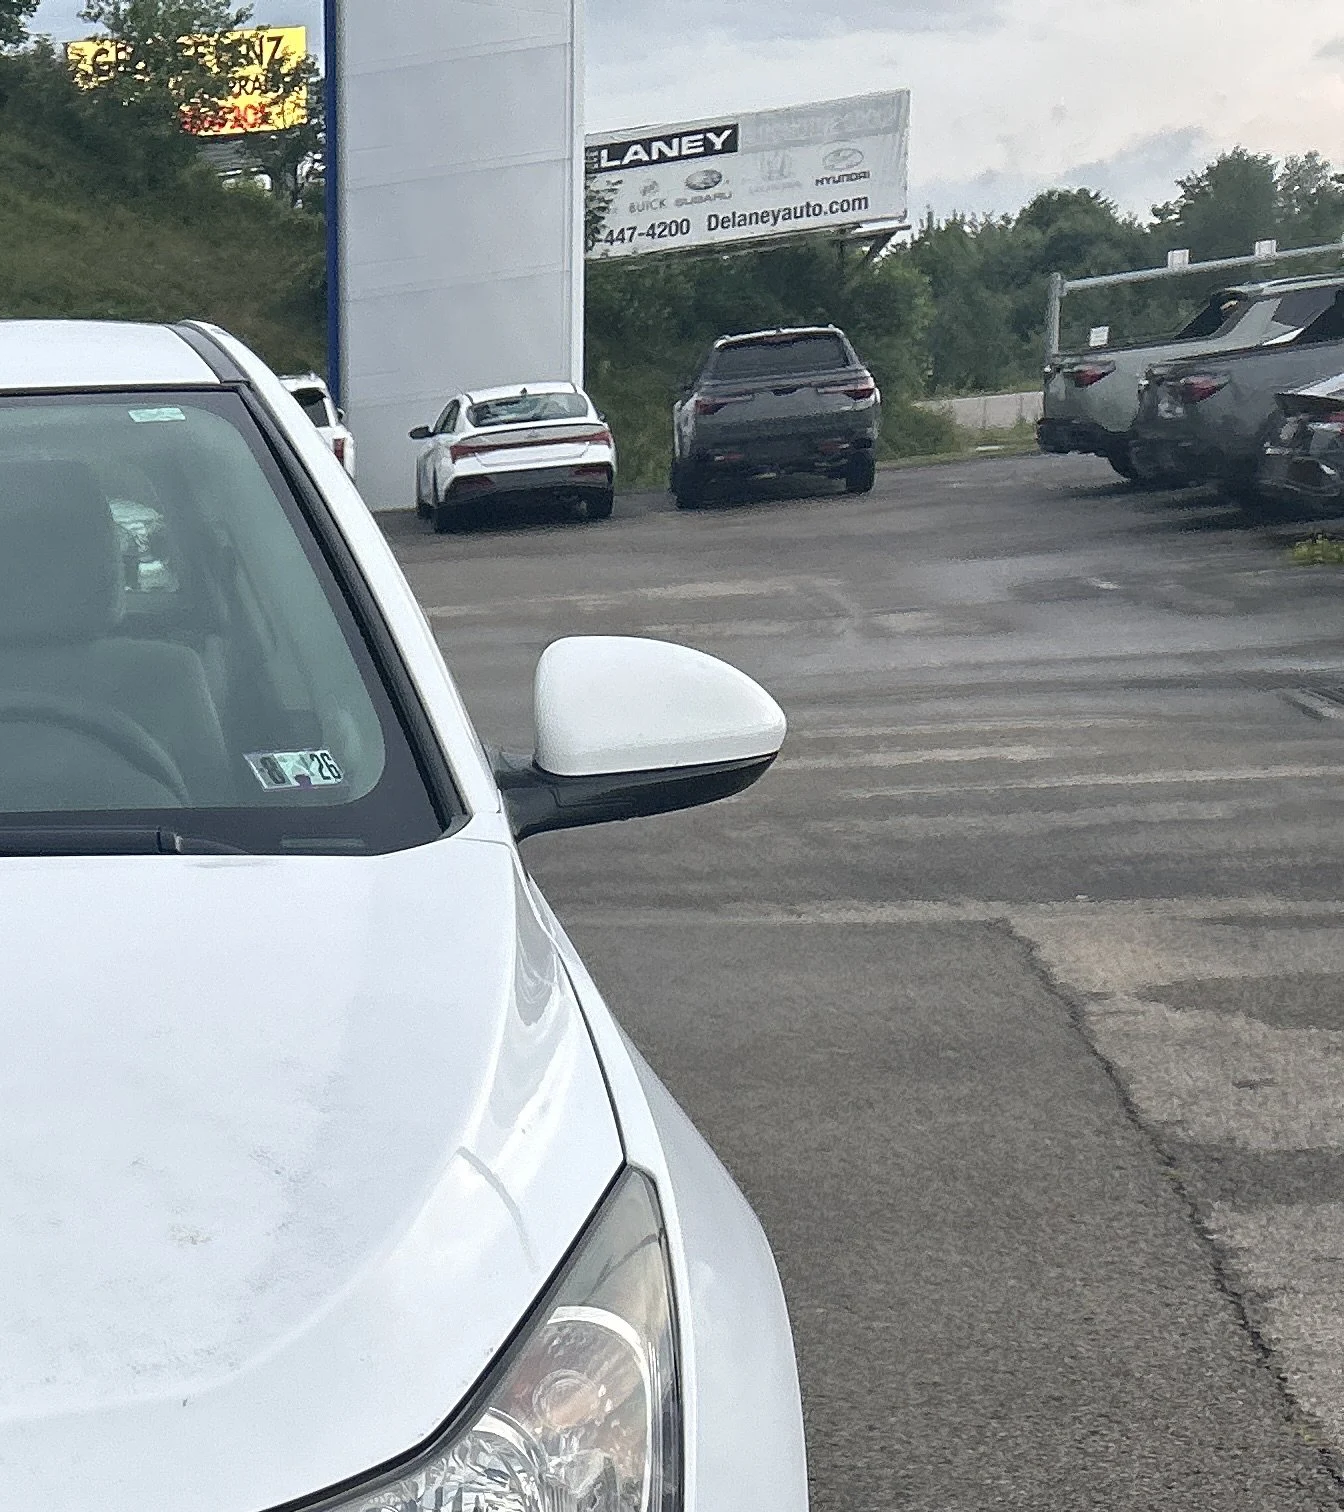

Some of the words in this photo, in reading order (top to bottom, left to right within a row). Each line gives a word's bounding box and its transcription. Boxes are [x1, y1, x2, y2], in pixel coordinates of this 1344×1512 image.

[814, 170, 871, 186] HYUNDAI
[628, 199, 667, 214] BUICK
[707, 196, 870, 231] Delaneyauto.com
[310, 752, 342, 780] 26
